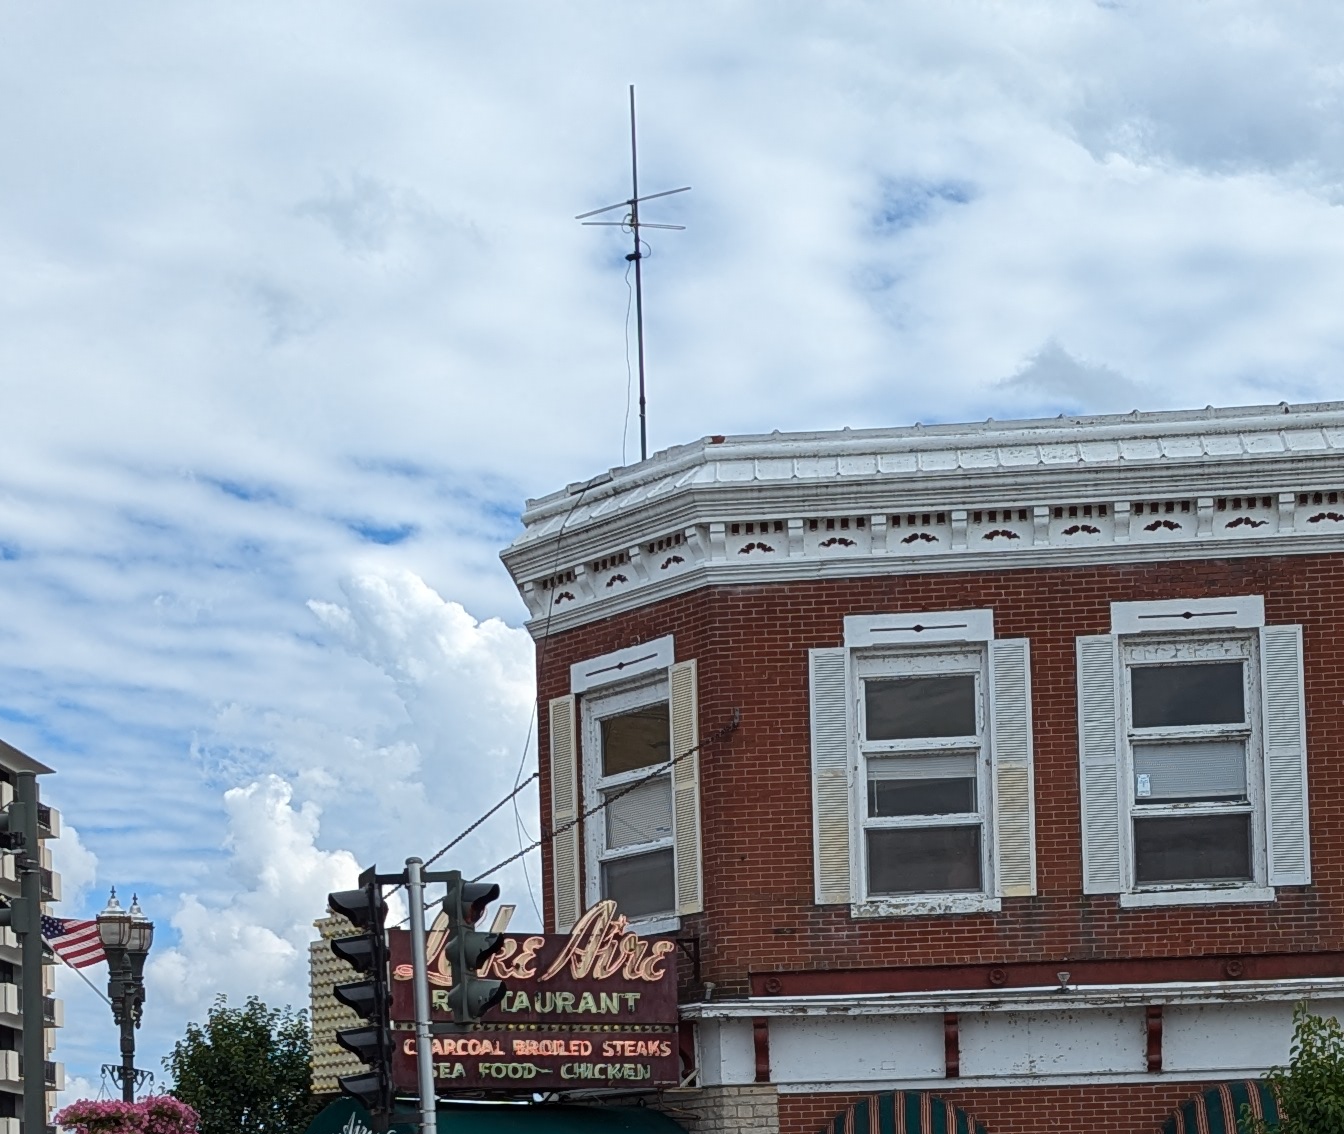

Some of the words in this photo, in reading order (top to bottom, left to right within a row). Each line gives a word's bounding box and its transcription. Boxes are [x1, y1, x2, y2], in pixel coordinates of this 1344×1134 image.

[393, 905, 545, 987] Lke
[537, 899, 675, 982] Aire
[432, 989, 642, 1016] RTAURANT
[403, 1038, 505, 1057] CARCOAL
[512, 1038, 594, 1058] BROILED
[602, 1040, 672, 1058] STEAKS
[479, 1062, 537, 1080] FOOD
[560, 1062, 652, 1081] CHICKEN
